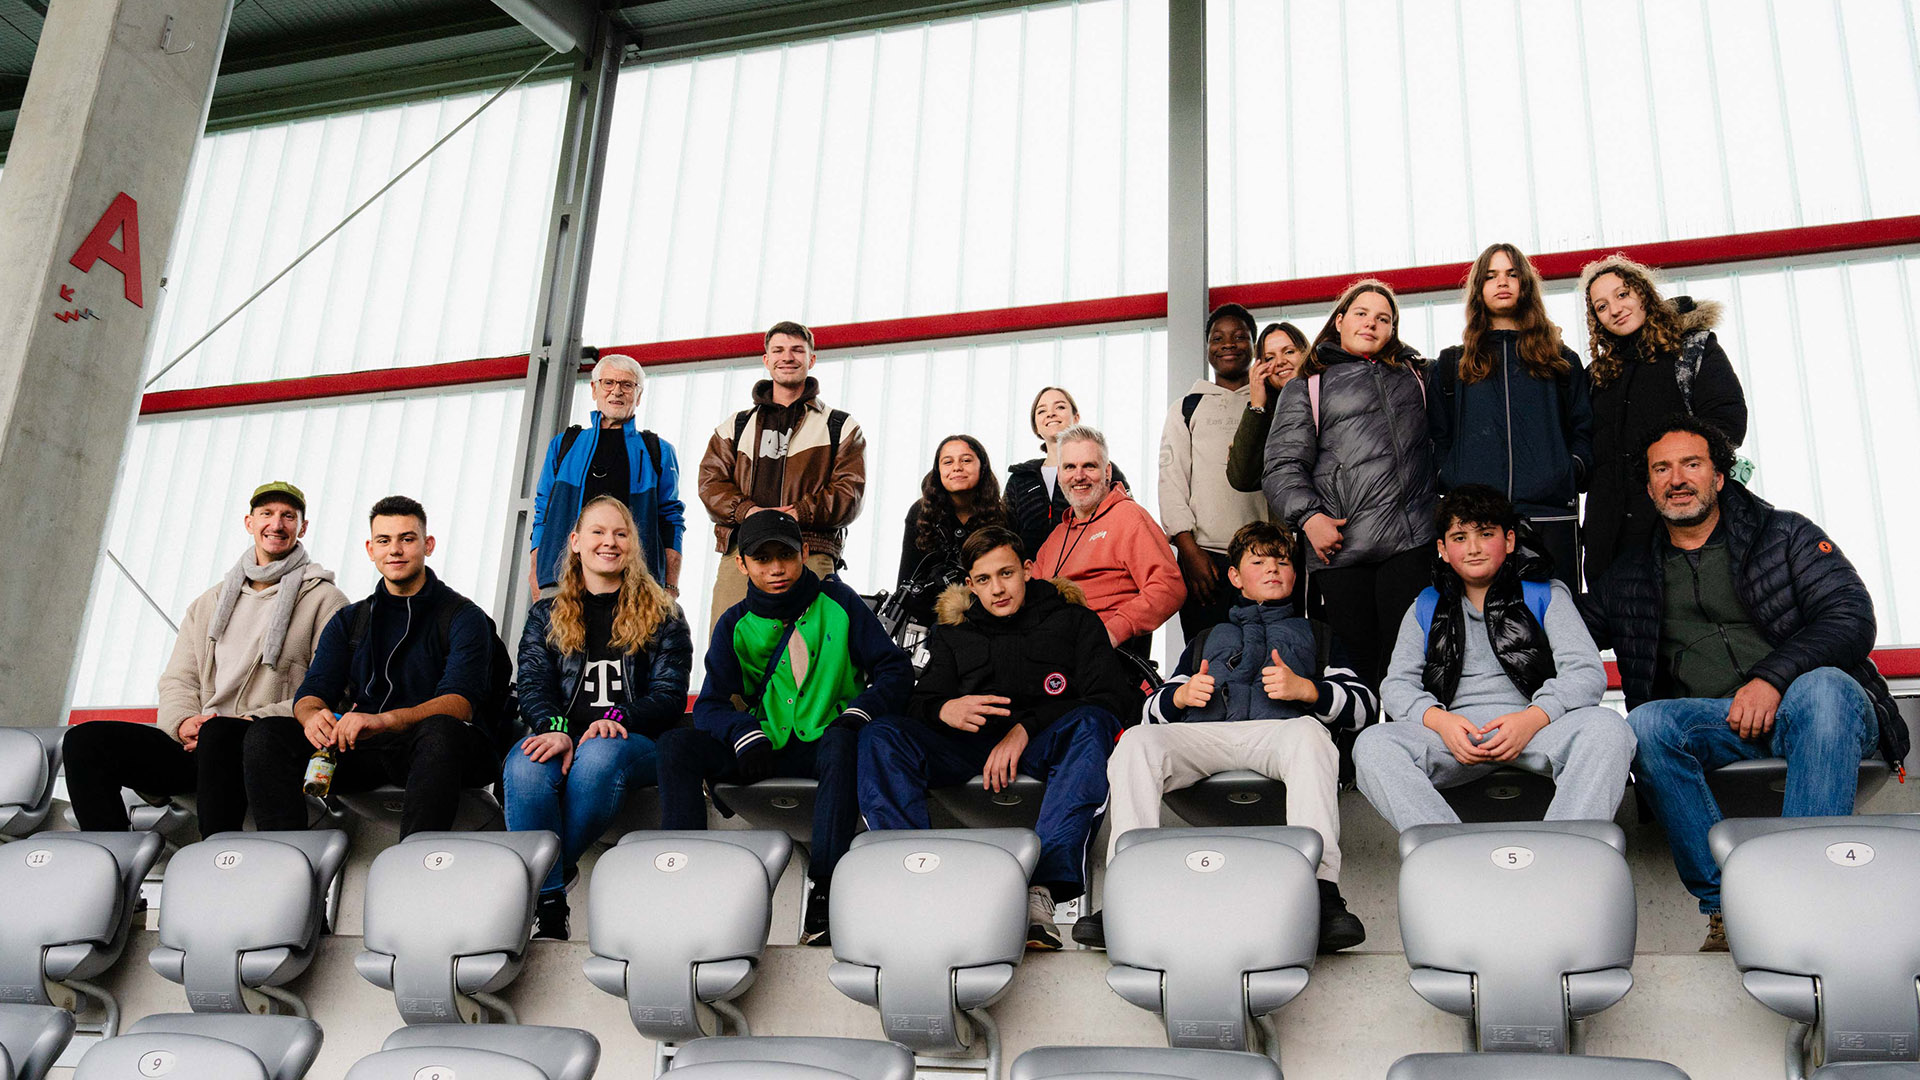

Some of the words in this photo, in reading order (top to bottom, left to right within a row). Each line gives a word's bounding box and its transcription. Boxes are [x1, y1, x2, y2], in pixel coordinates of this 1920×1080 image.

[69, 191, 143, 309] A
[32, 854, 45, 863] 11
[222, 855, 235, 865] 10
[1508, 852, 1517, 864] 5
[1846, 849, 1856, 860] 4
[435, 856, 443, 866] 9
[667, 857, 675, 868] 8
[918, 857, 926, 868] 7
[1201, 856, 1210, 867] 6
[153, 1058, 161, 1071] 9
